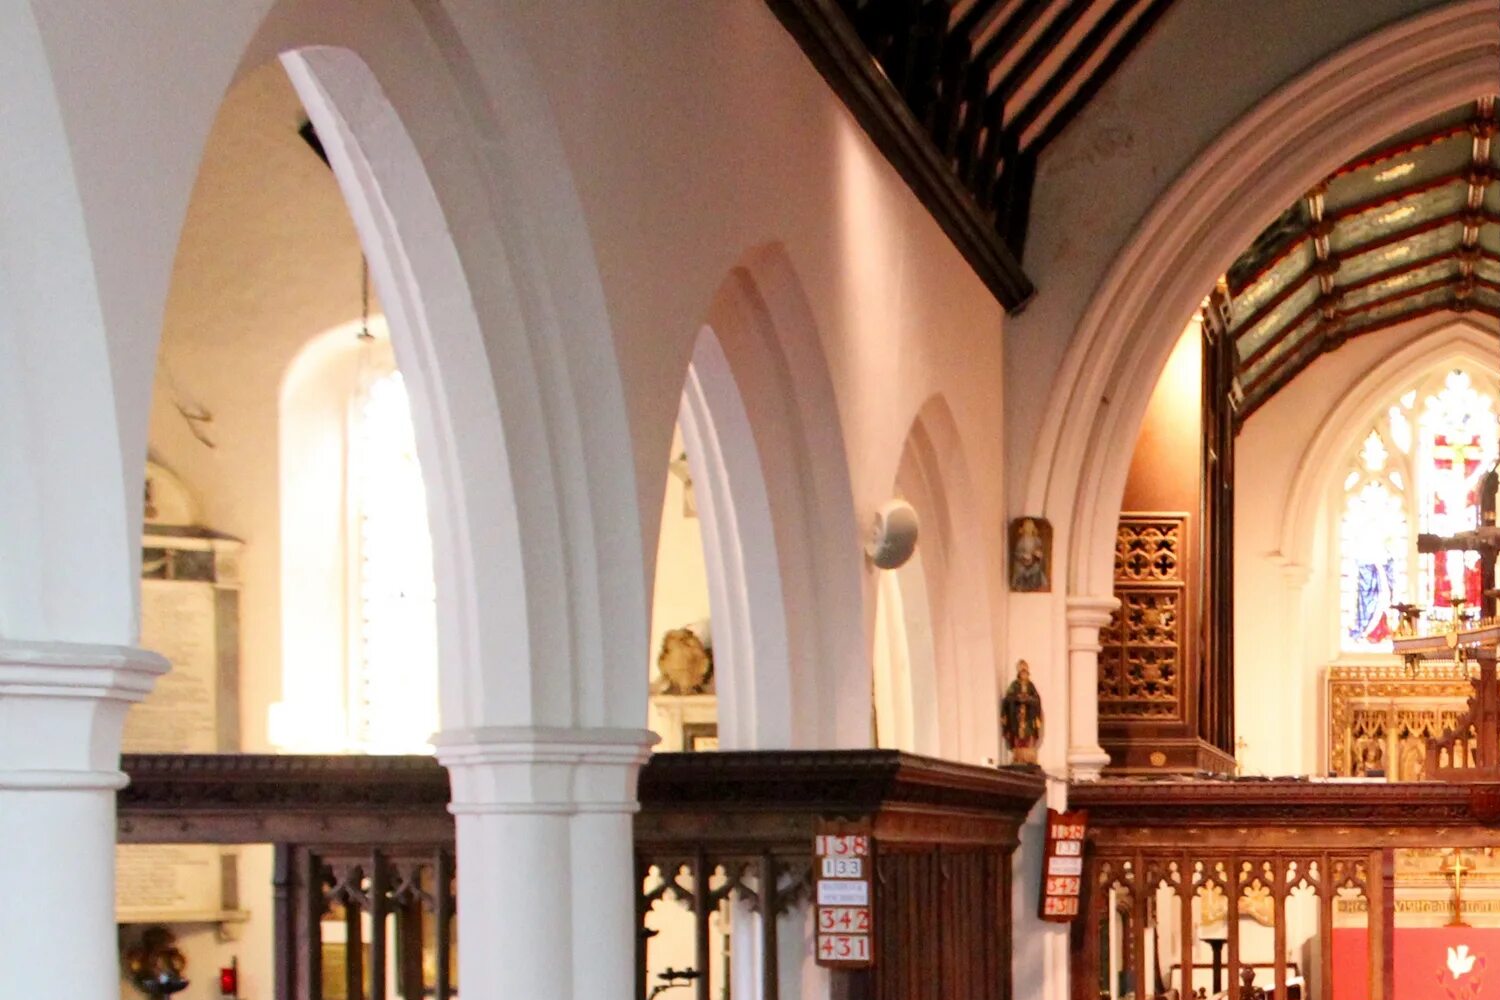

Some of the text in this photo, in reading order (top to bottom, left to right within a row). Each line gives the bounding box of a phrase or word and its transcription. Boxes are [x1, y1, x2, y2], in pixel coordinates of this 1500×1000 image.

[1055, 825, 1083, 840] 138
[822, 834, 868, 856] 138
[826, 861, 859, 874] 133
[1048, 878, 1078, 894] 342
[1047, 896, 1075, 914] 431
[820, 910, 870, 929] 342
[822, 936, 865, 957] 431
